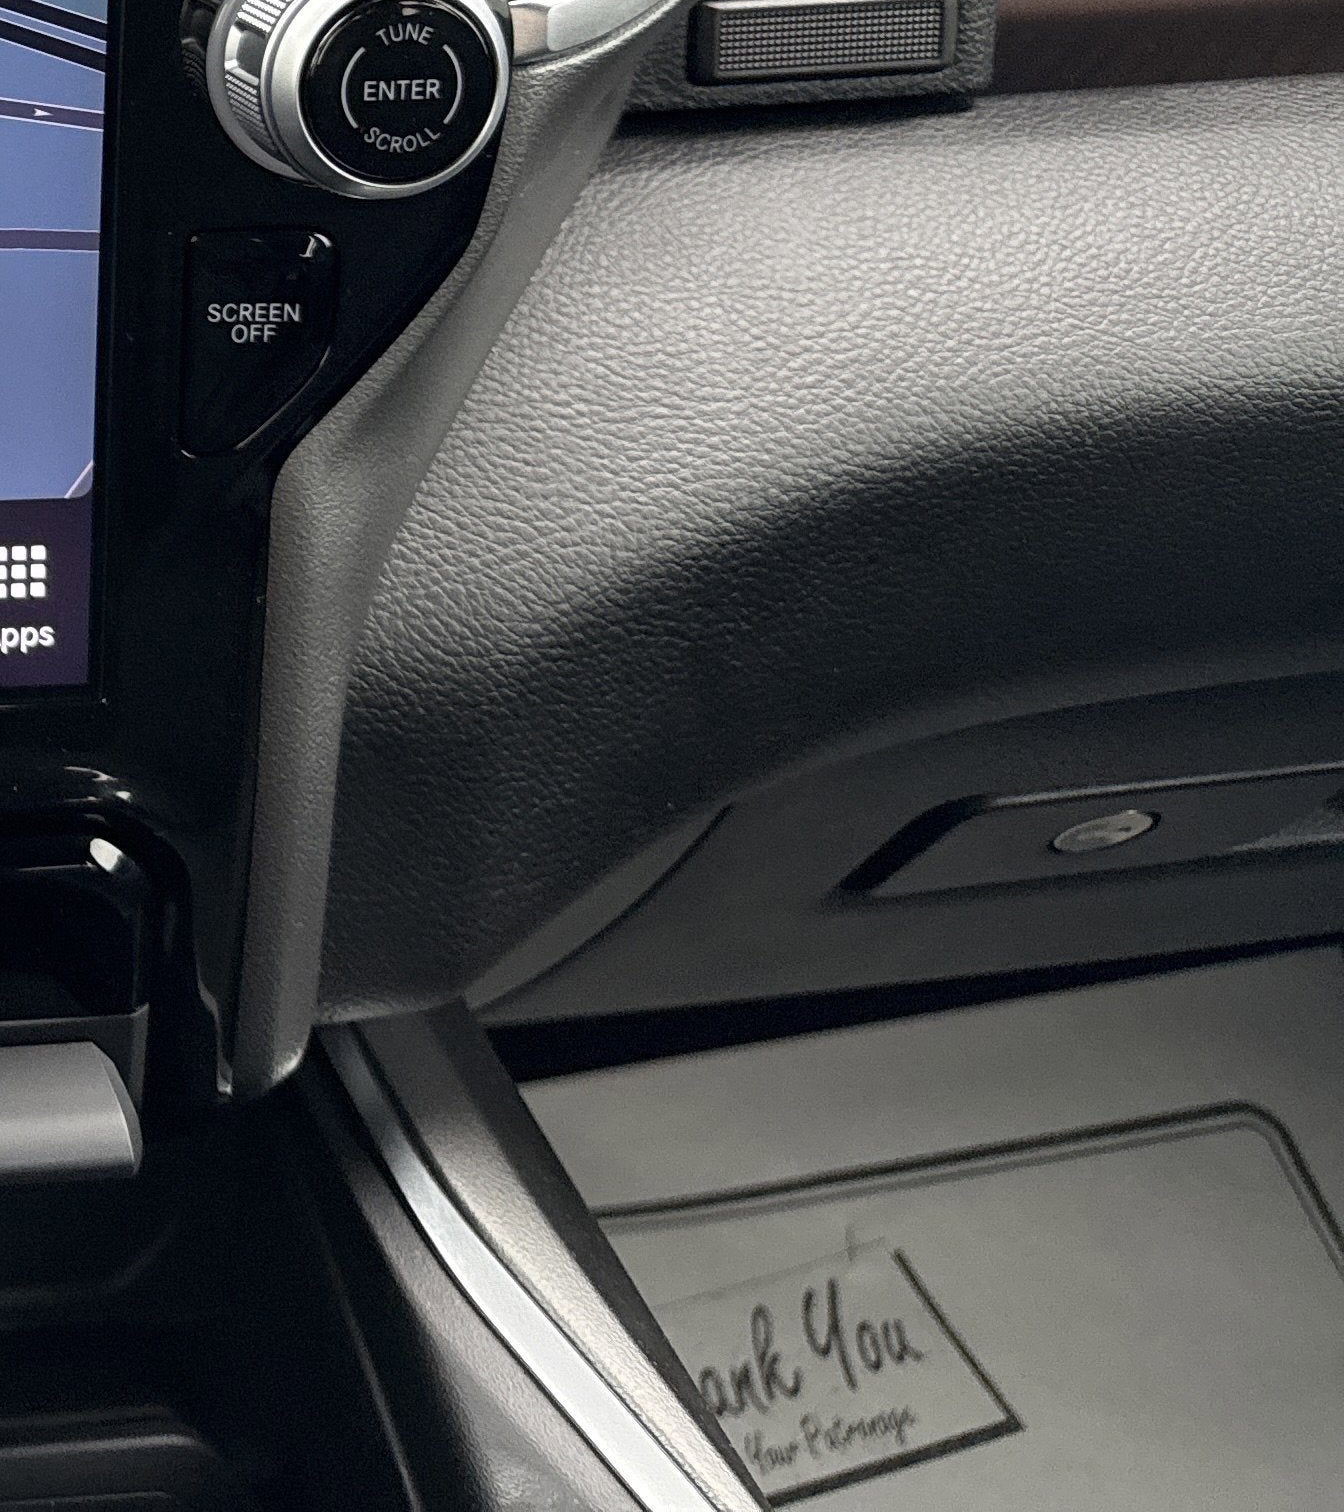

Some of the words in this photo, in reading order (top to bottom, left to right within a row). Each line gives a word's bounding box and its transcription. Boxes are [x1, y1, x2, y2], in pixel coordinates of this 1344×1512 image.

[375, 24, 436, 45] TUNE
[363, 79, 440, 101] ENTER
[363, 126, 441, 153] SCROLL
[207, 303, 301, 323] SCREEN
[231, 324, 277, 343] OFF
[698, 1304, 803, 1417] ank
[802, 1278, 924, 1392] You
